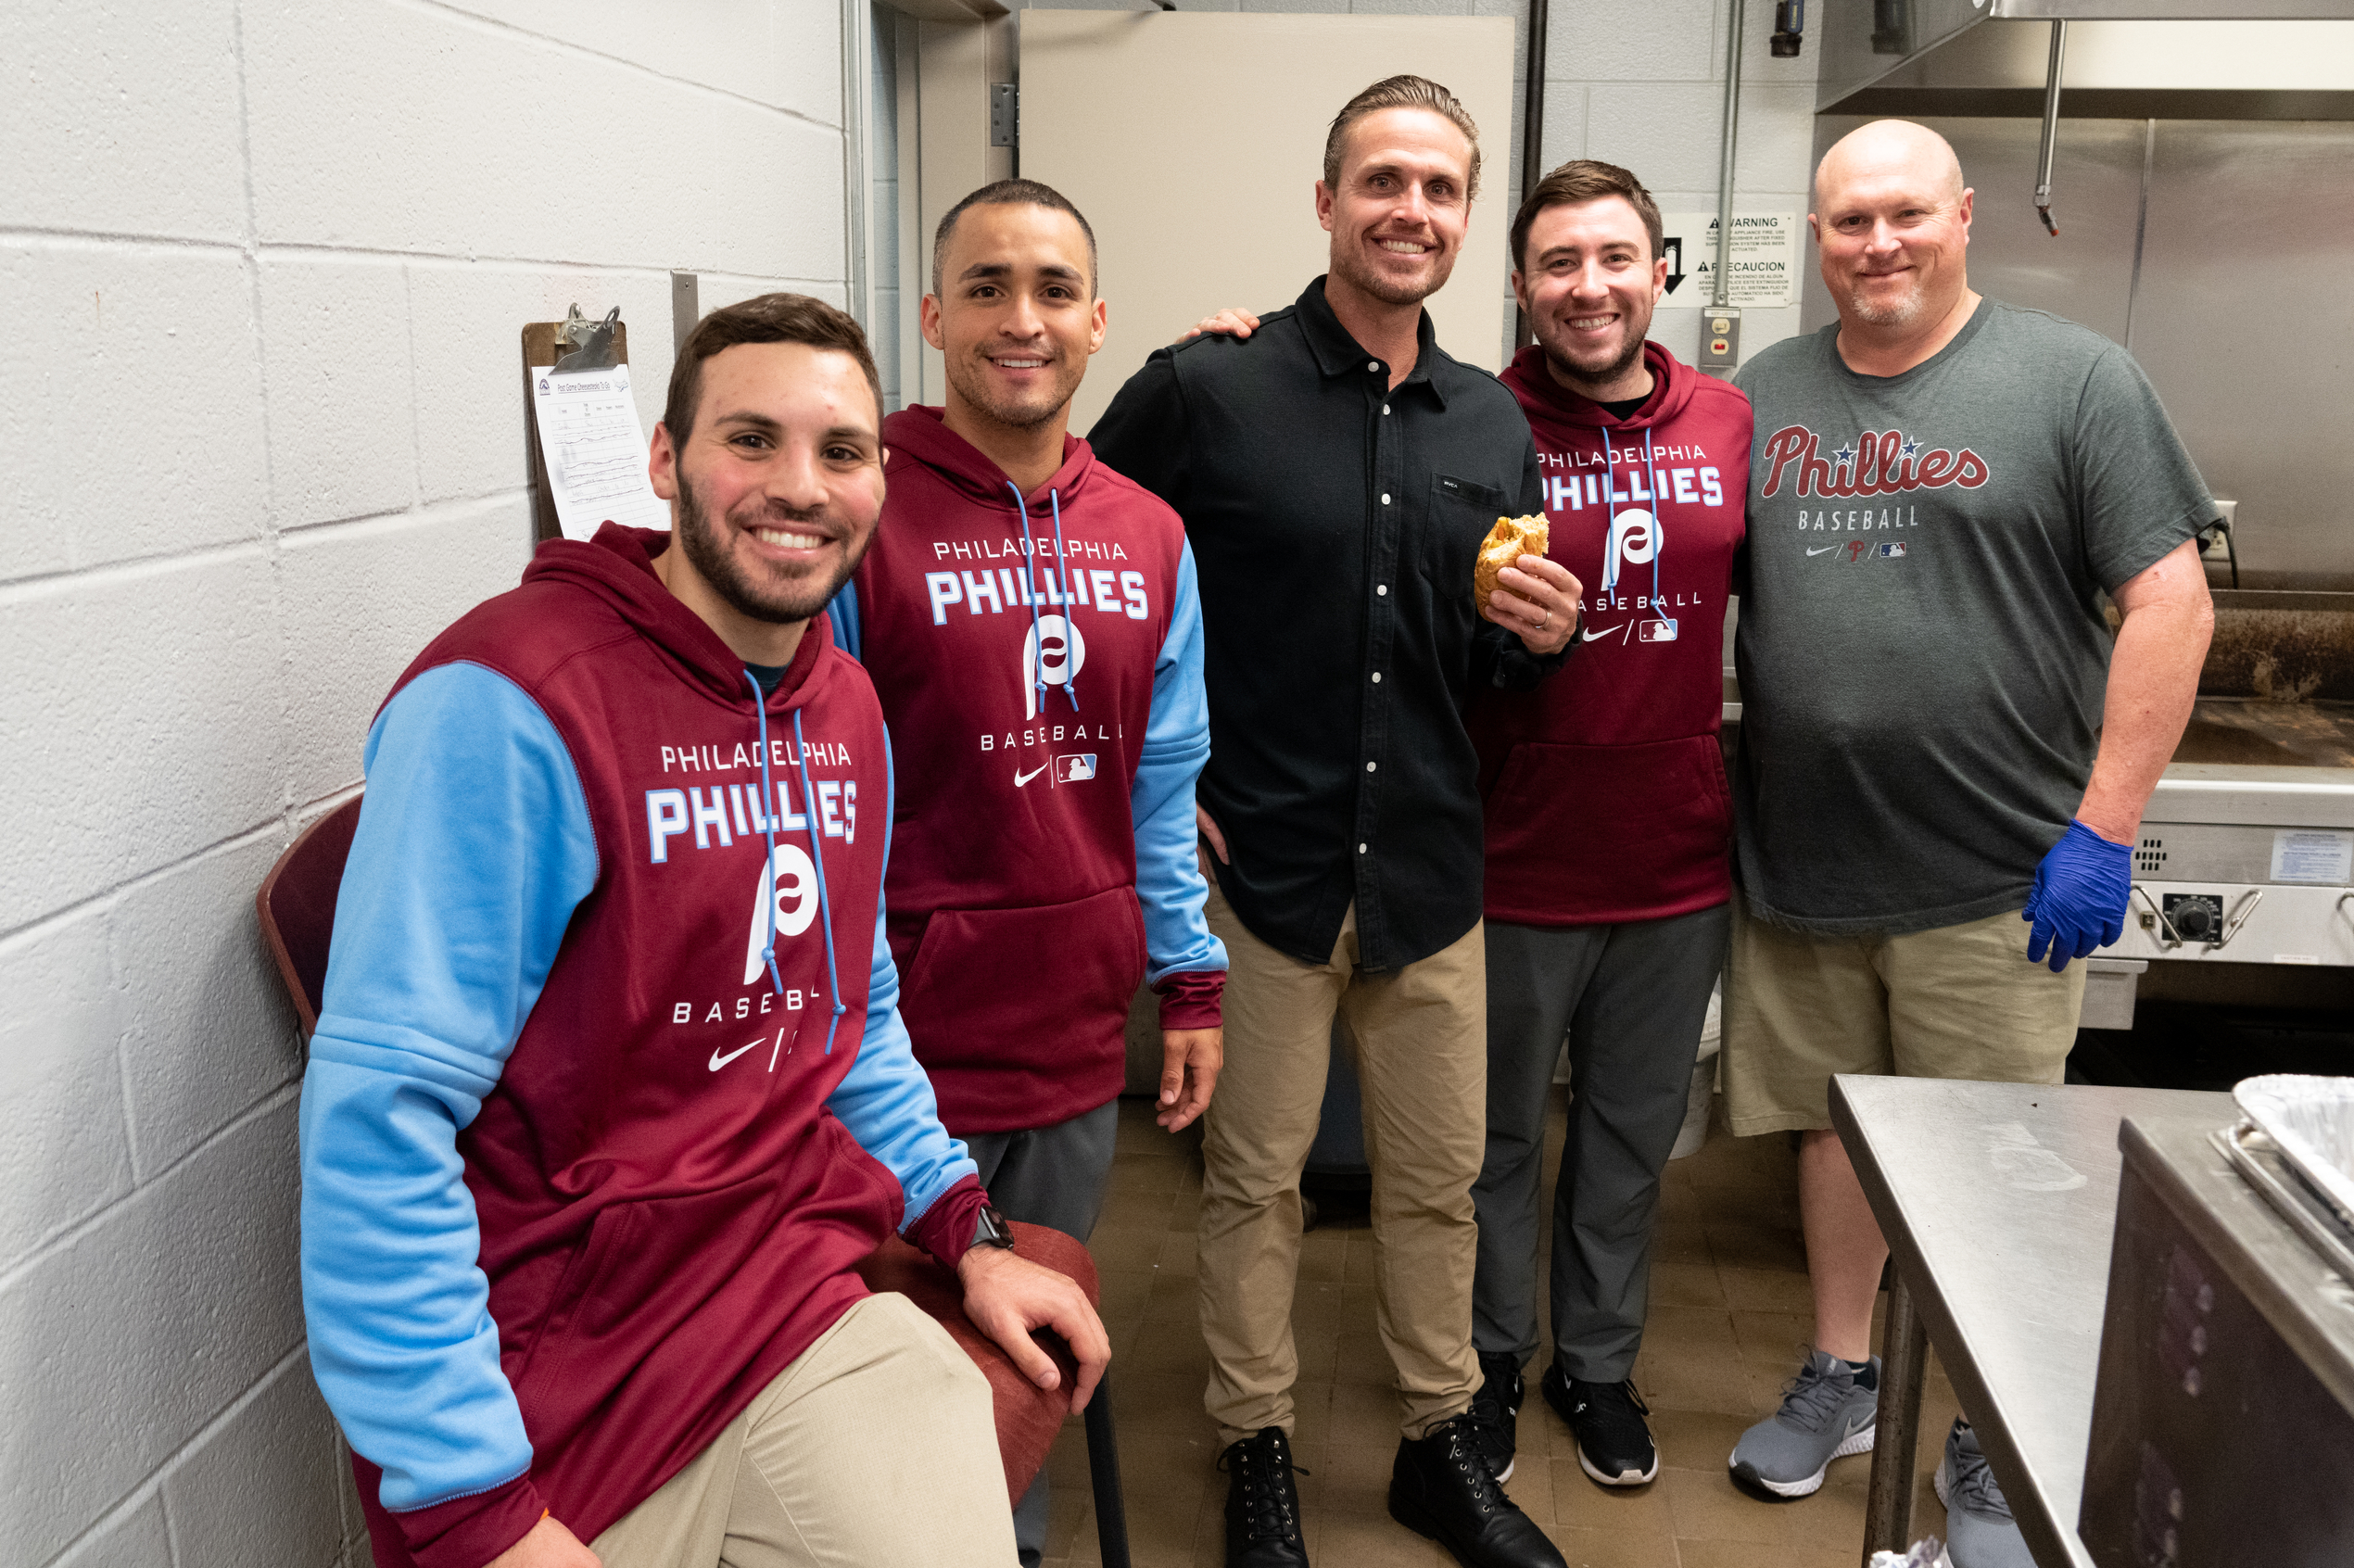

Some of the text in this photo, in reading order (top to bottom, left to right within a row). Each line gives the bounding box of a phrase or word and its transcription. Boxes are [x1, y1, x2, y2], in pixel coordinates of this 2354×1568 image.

[1711, 261, 1785, 272] PECAUCION
[557, 384, 566, 392] Post
[566, 383, 577, 392] Game
[600, 381, 605, 389] To
[604, 381, 611, 389] Go
[1537, 445, 1707, 468] PHILADELPHIA
[1761, 424, 1990, 499] Phillies
[1798, 505, 1918, 531] BASEBALL
[933, 537, 1128, 561] PHILADELPHIA
[925, 567, 1149, 626] PHILLIES
[1578, 591, 1702, 612] ASEBALL
[661, 740, 852, 773] PHILADELPHIA
[645, 779, 856, 864] PHILLIES
